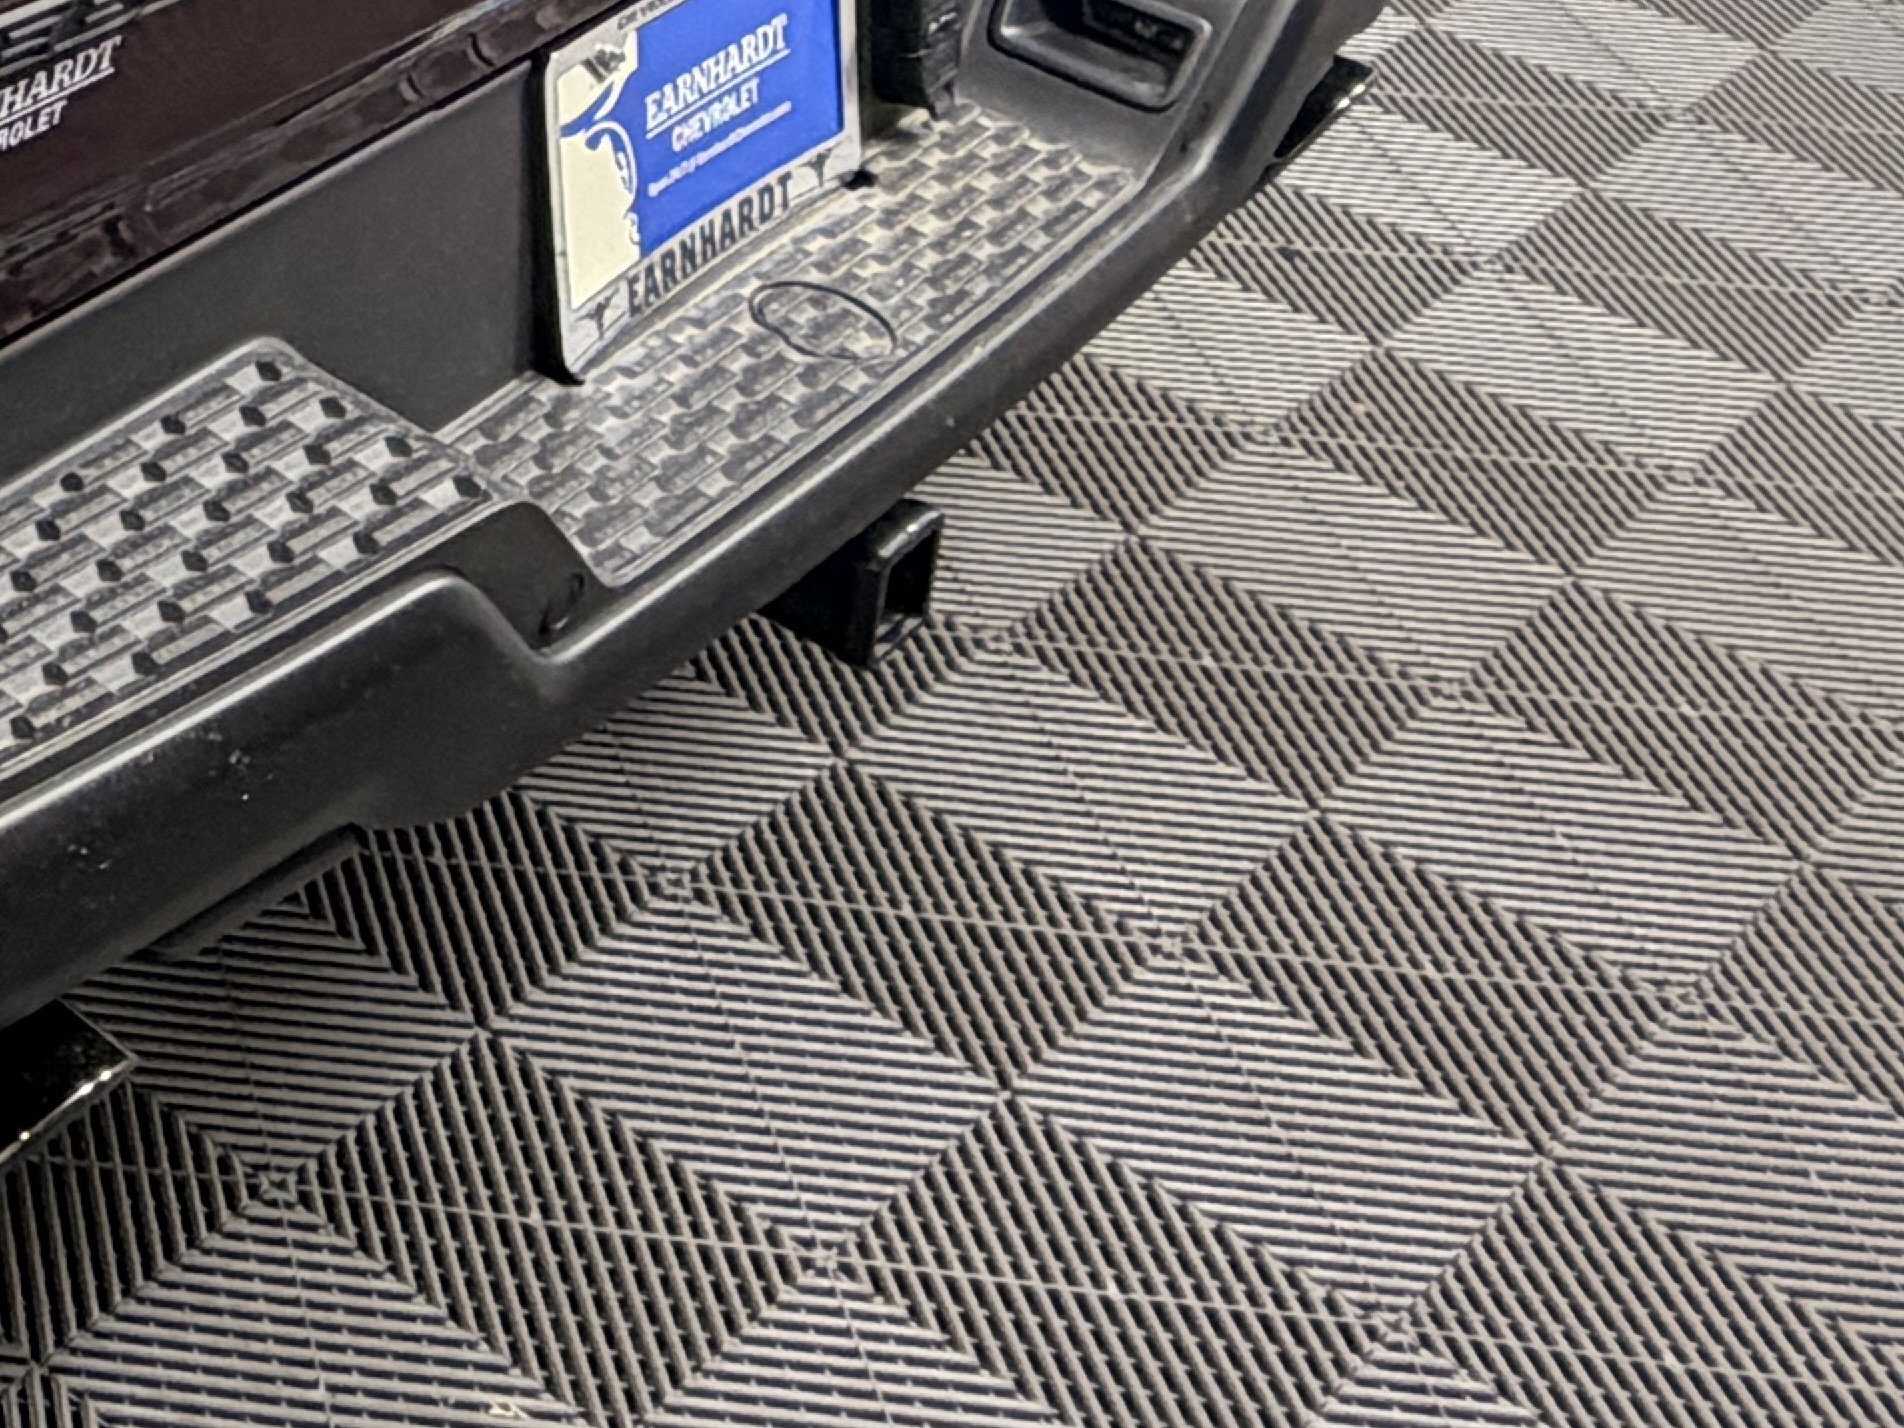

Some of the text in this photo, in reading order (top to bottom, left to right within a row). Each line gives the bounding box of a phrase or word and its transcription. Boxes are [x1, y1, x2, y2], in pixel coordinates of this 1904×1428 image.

[644, 12, 789, 130] EARNHARDT
[671, 76, 761, 153] CHEVROLET
[626, 170, 793, 318] EARNHARDT
